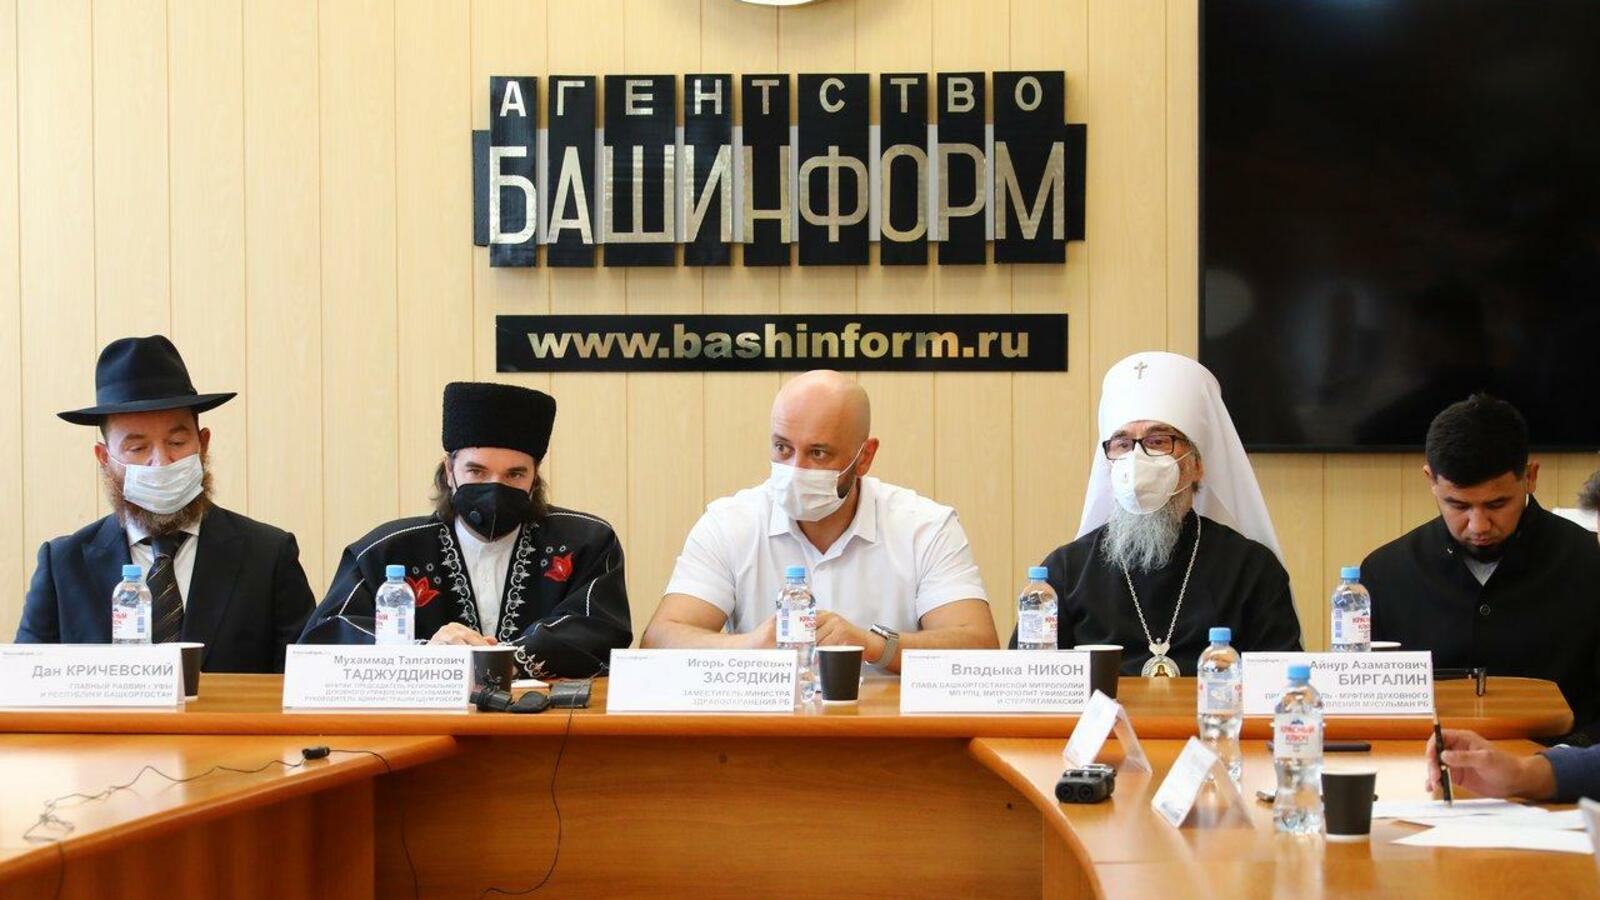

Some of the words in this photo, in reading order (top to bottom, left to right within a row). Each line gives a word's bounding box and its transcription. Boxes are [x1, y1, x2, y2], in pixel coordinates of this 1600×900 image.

[500, 76, 1043, 116] АГЕНТСТВО
[489, 141, 1065, 244] БАШИНФОРМ
[527, 322, 1030, 359] www.bashinform.ru
[334, 655, 395, 667] Мухаммад
[398, 655, 466, 666] Талгатович
[687, 658, 724, 669] Игорь
[728, 658, 792, 669] Сергеевич
[1310, 660, 1349, 672] Айнур
[1352, 660, 1428, 670] Азаматович
[32, 665, 62, 679] Дан
[66, 663, 174, 677] КРИЧЕВСКИЙ
[343, 668, 464, 682] ТАДЖУДДИНОВ
[951, 664, 1023, 677] Владыка
[1028, 664, 1085, 676] НИКОН
[703, 672, 791, 685] ЗАСЯДКИН
[1338, 673, 1428, 685] БИРГАЛИН
[1377, 692, 1429, 700] ДУХОВНОГО
